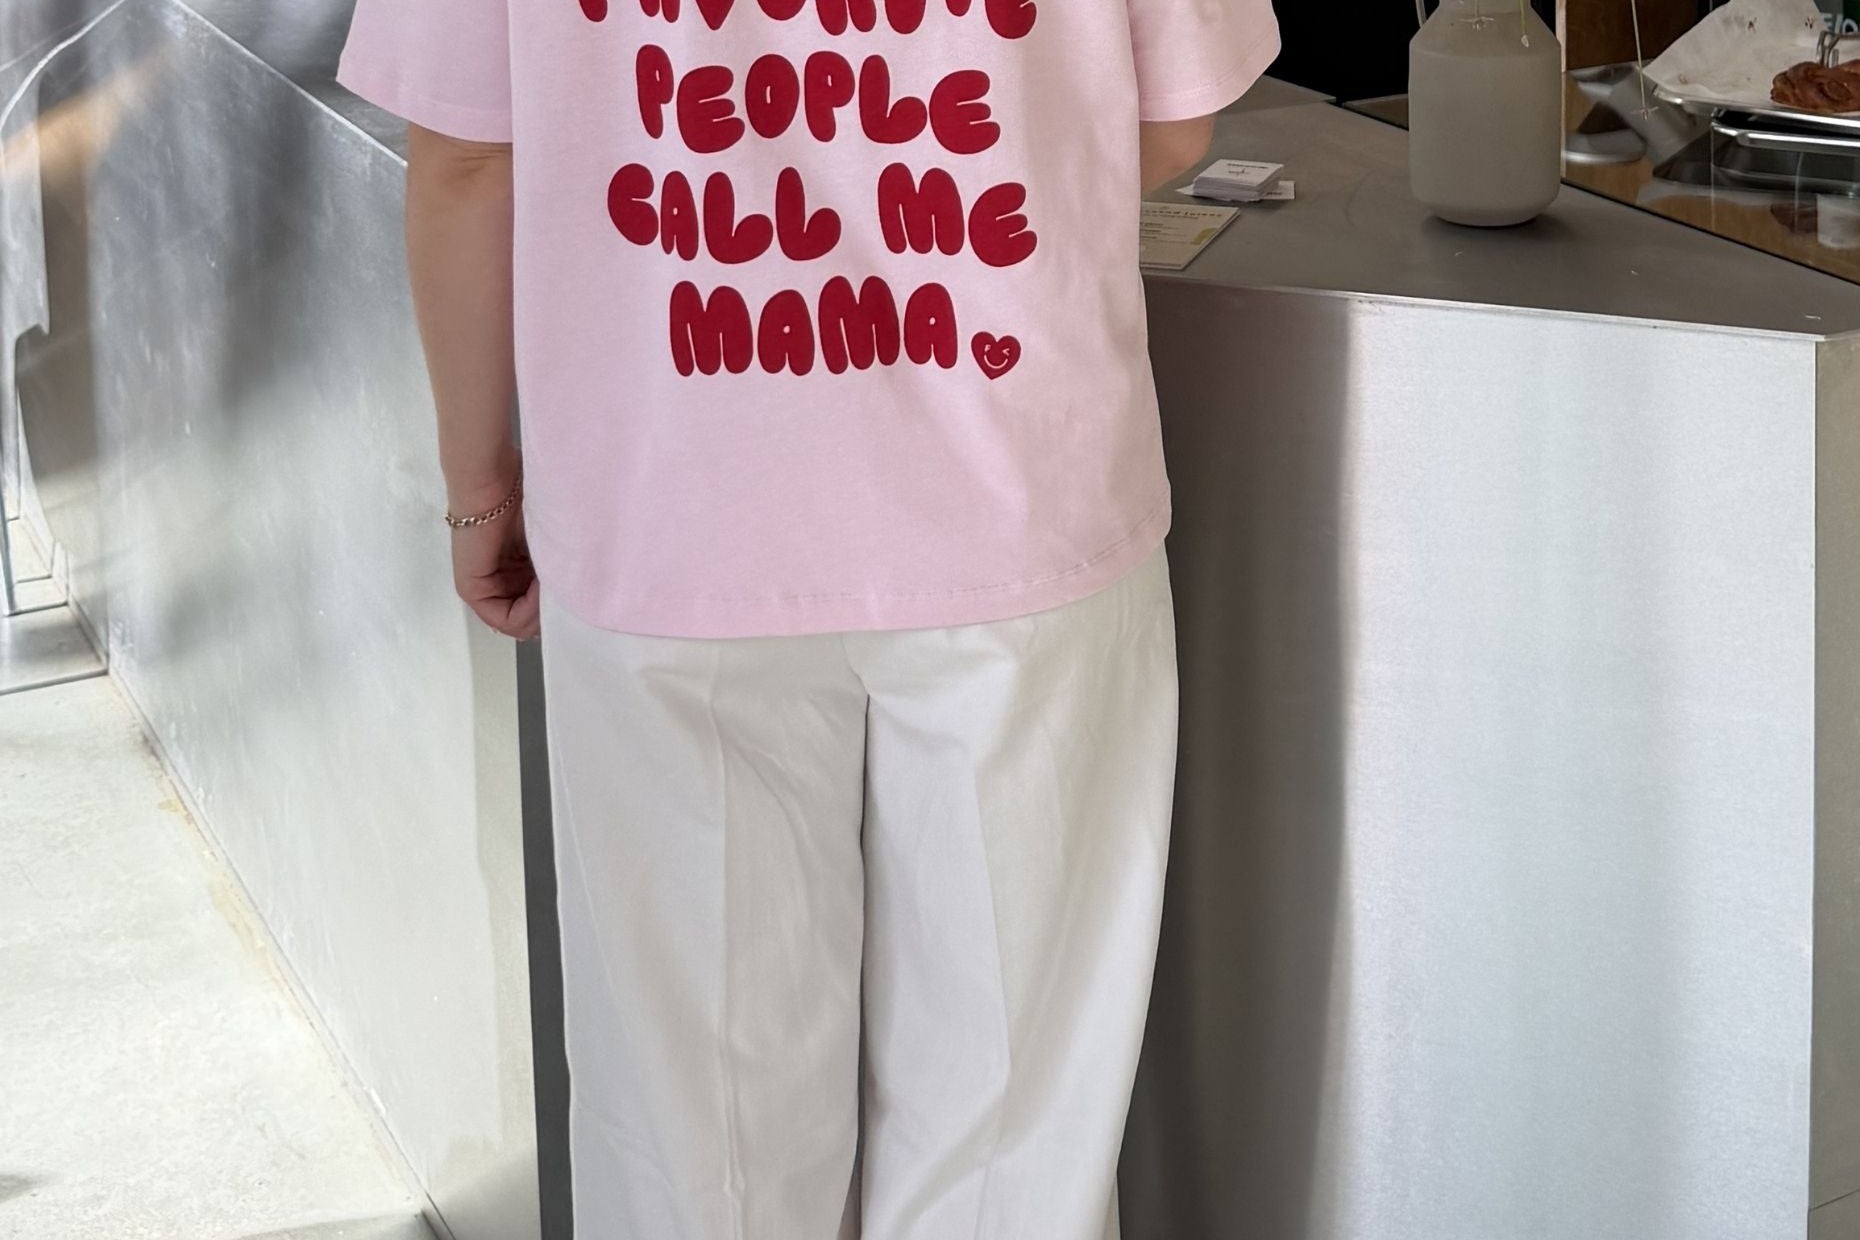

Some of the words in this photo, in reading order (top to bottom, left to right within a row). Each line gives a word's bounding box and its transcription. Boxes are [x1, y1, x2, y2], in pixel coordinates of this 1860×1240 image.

[636, 45, 999, 155] PEOPLE
[607, 164, 840, 264] CALL
[877, 163, 1036, 268] ME
[669, 276, 957, 376] MAMA
